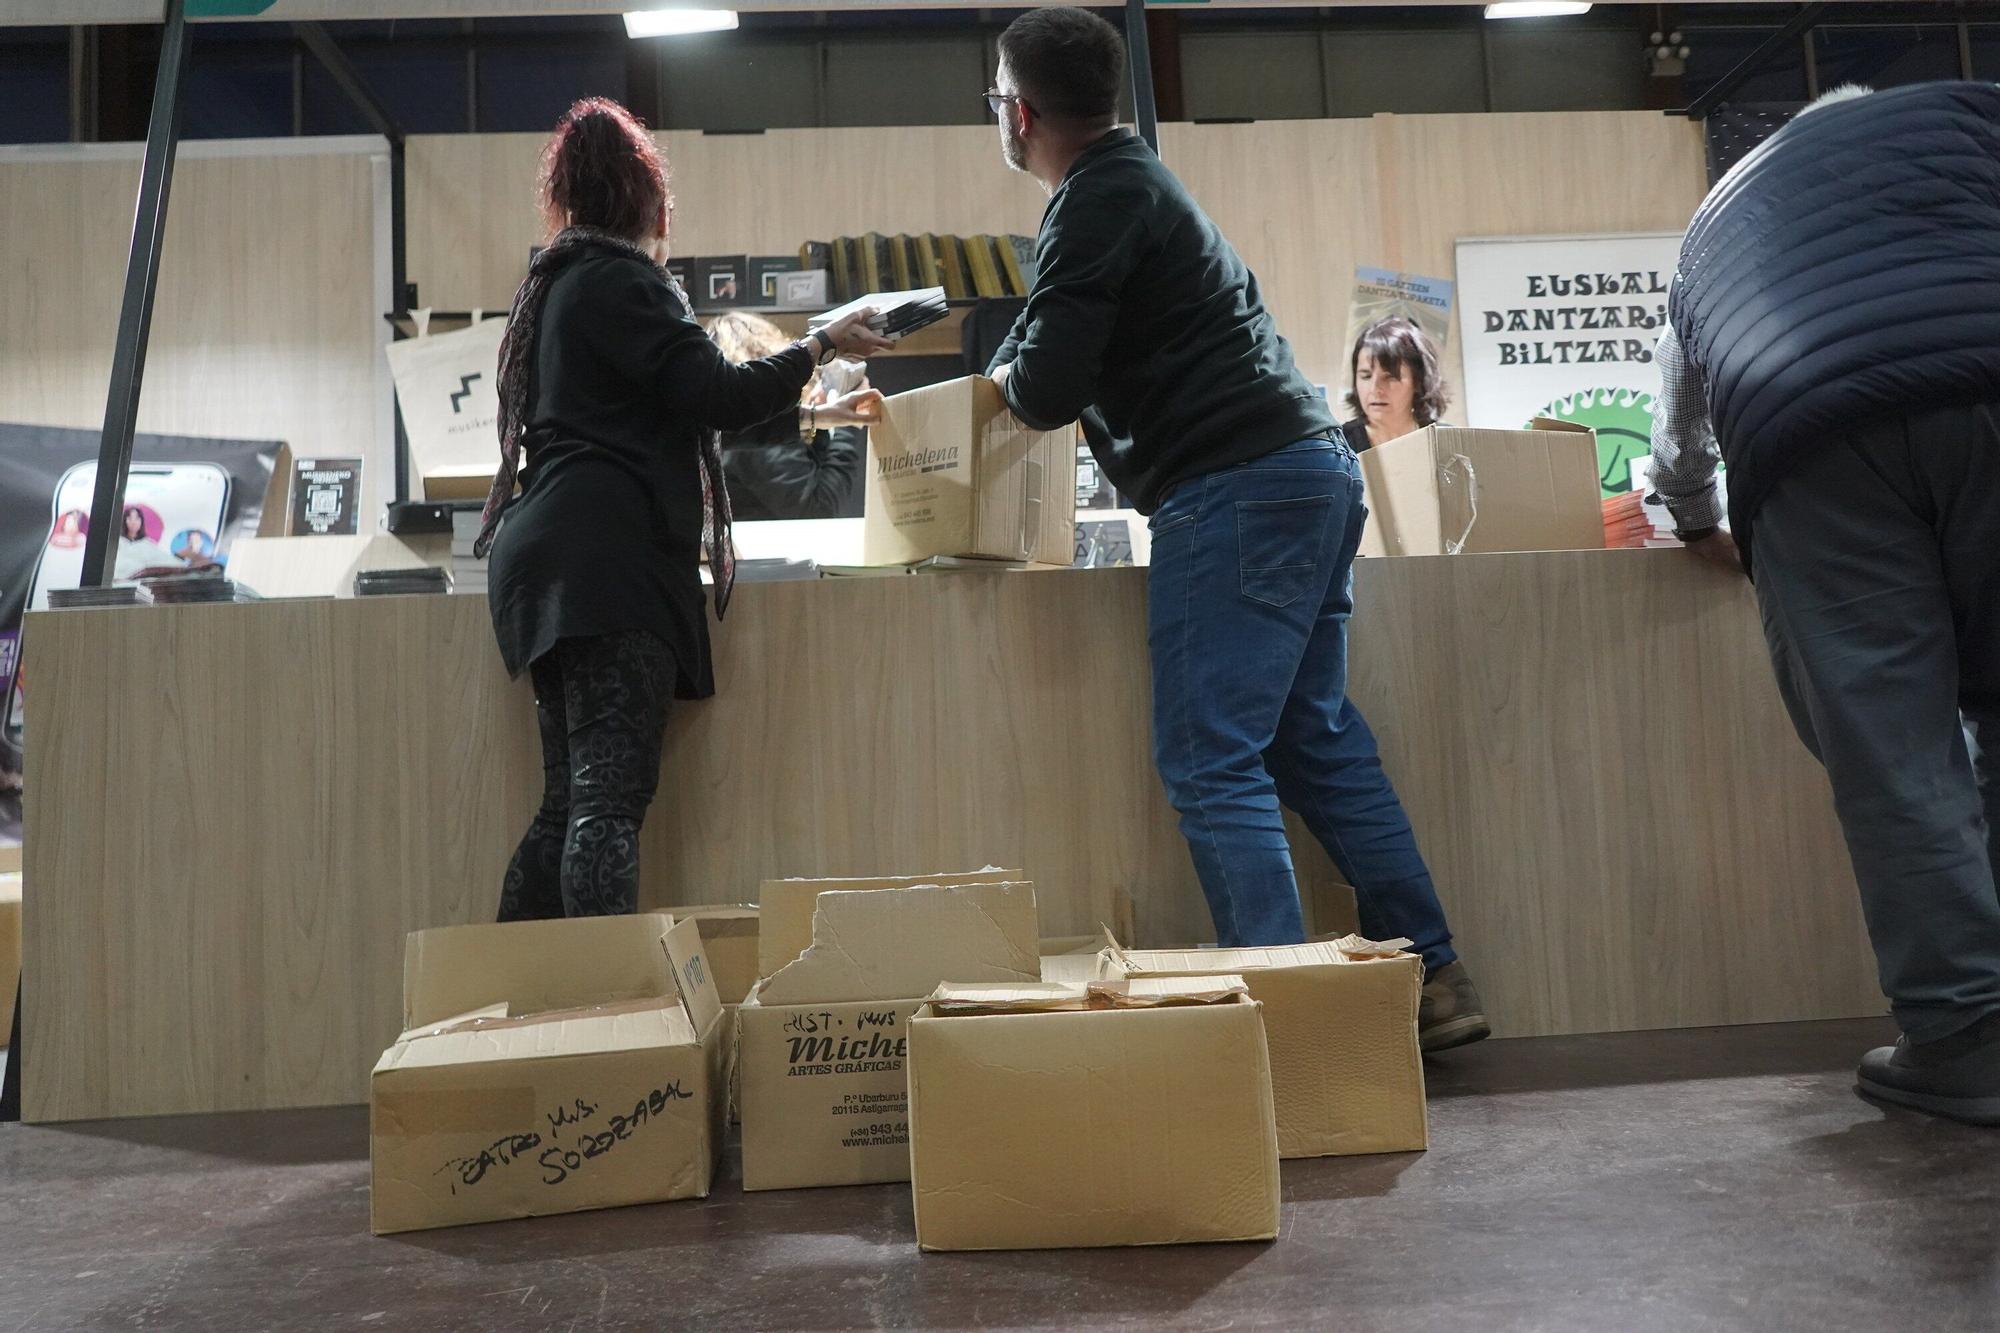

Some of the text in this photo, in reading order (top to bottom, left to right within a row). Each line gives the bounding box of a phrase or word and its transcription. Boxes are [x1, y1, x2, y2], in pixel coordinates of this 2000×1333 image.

[1527, 271, 1667, 298] EUSKAL
[877, 446, 959, 474] Michelena
[787, 1060, 902, 1076] ARTES GRÁFICAS
[832, 1105, 859, 1115] 20115
[870, 1123, 892, 1135] 943
